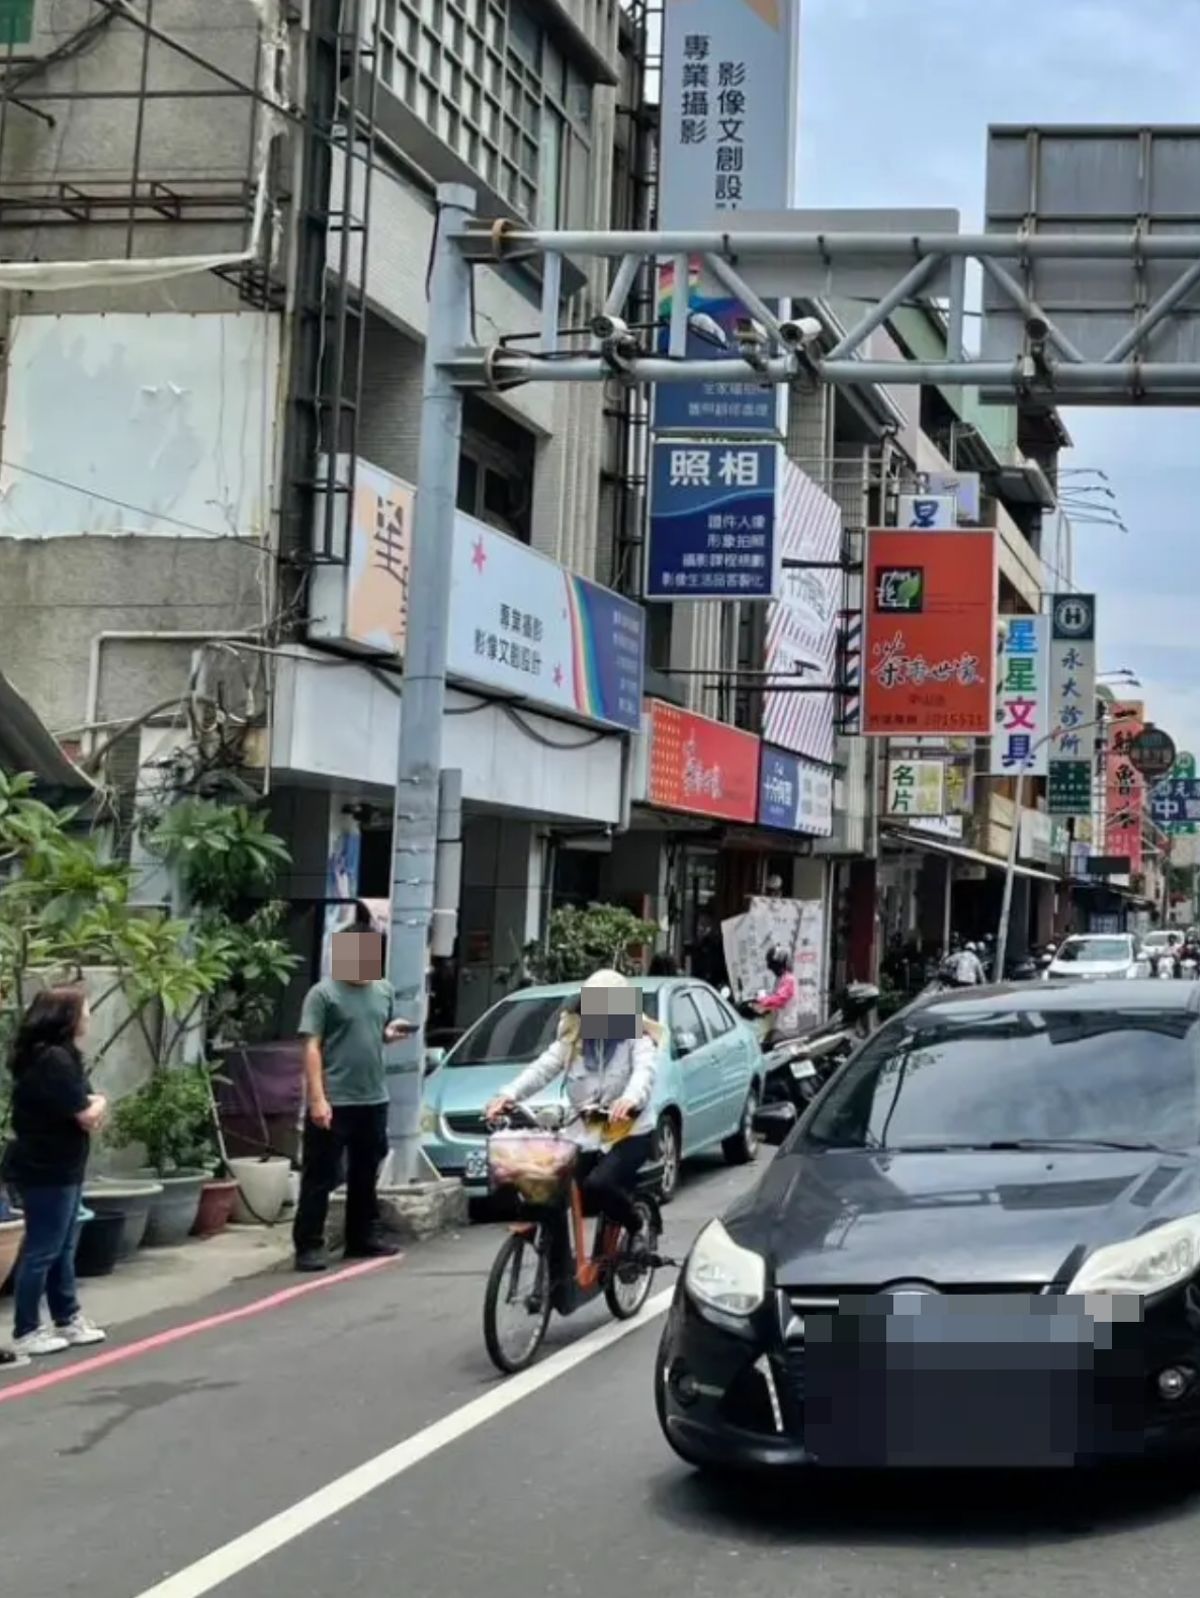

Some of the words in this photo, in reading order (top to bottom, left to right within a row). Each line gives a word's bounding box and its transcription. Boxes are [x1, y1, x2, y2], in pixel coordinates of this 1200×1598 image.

[680, 34, 710, 145] 專業攝影
[669, 450, 759, 486] 照相
[1001, 619, 1038, 768] 星星文具
[1059, 648, 1084, 755] 永大診所
[891, 764, 914, 812] 名片
